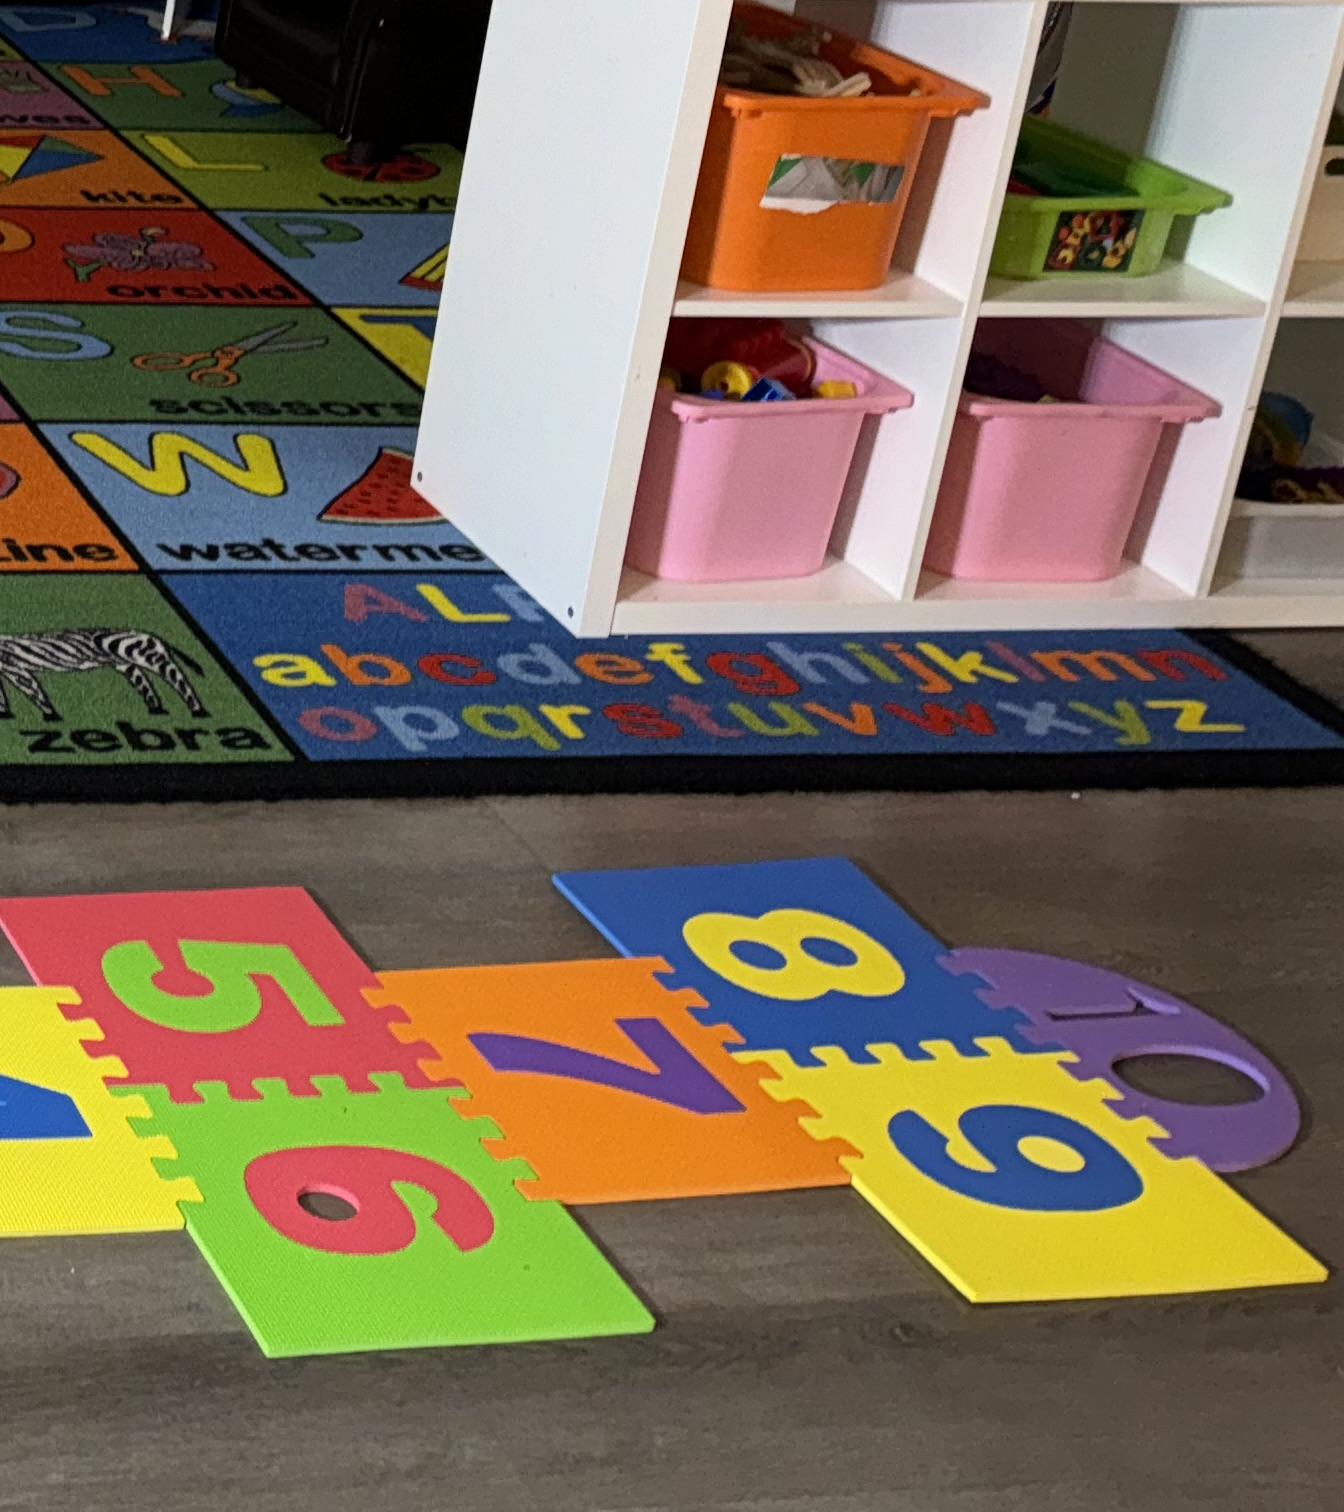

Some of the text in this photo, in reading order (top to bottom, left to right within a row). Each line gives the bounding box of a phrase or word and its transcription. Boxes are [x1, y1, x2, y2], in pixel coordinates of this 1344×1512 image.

[78, 189, 184, 206] kite
[106, 282, 307, 302] orchid
[149, 397, 421, 420] scissors
[68, 430, 288, 498] W
[18, 721, 271, 756] zebra
[100, 937, 346, 1035] 5
[681, 907, 908, 1002] 8
[466, 1016, 749, 1117] 7
[885, 1101, 1146, 1214] 9
[242, 1142, 497, 1257] 6
